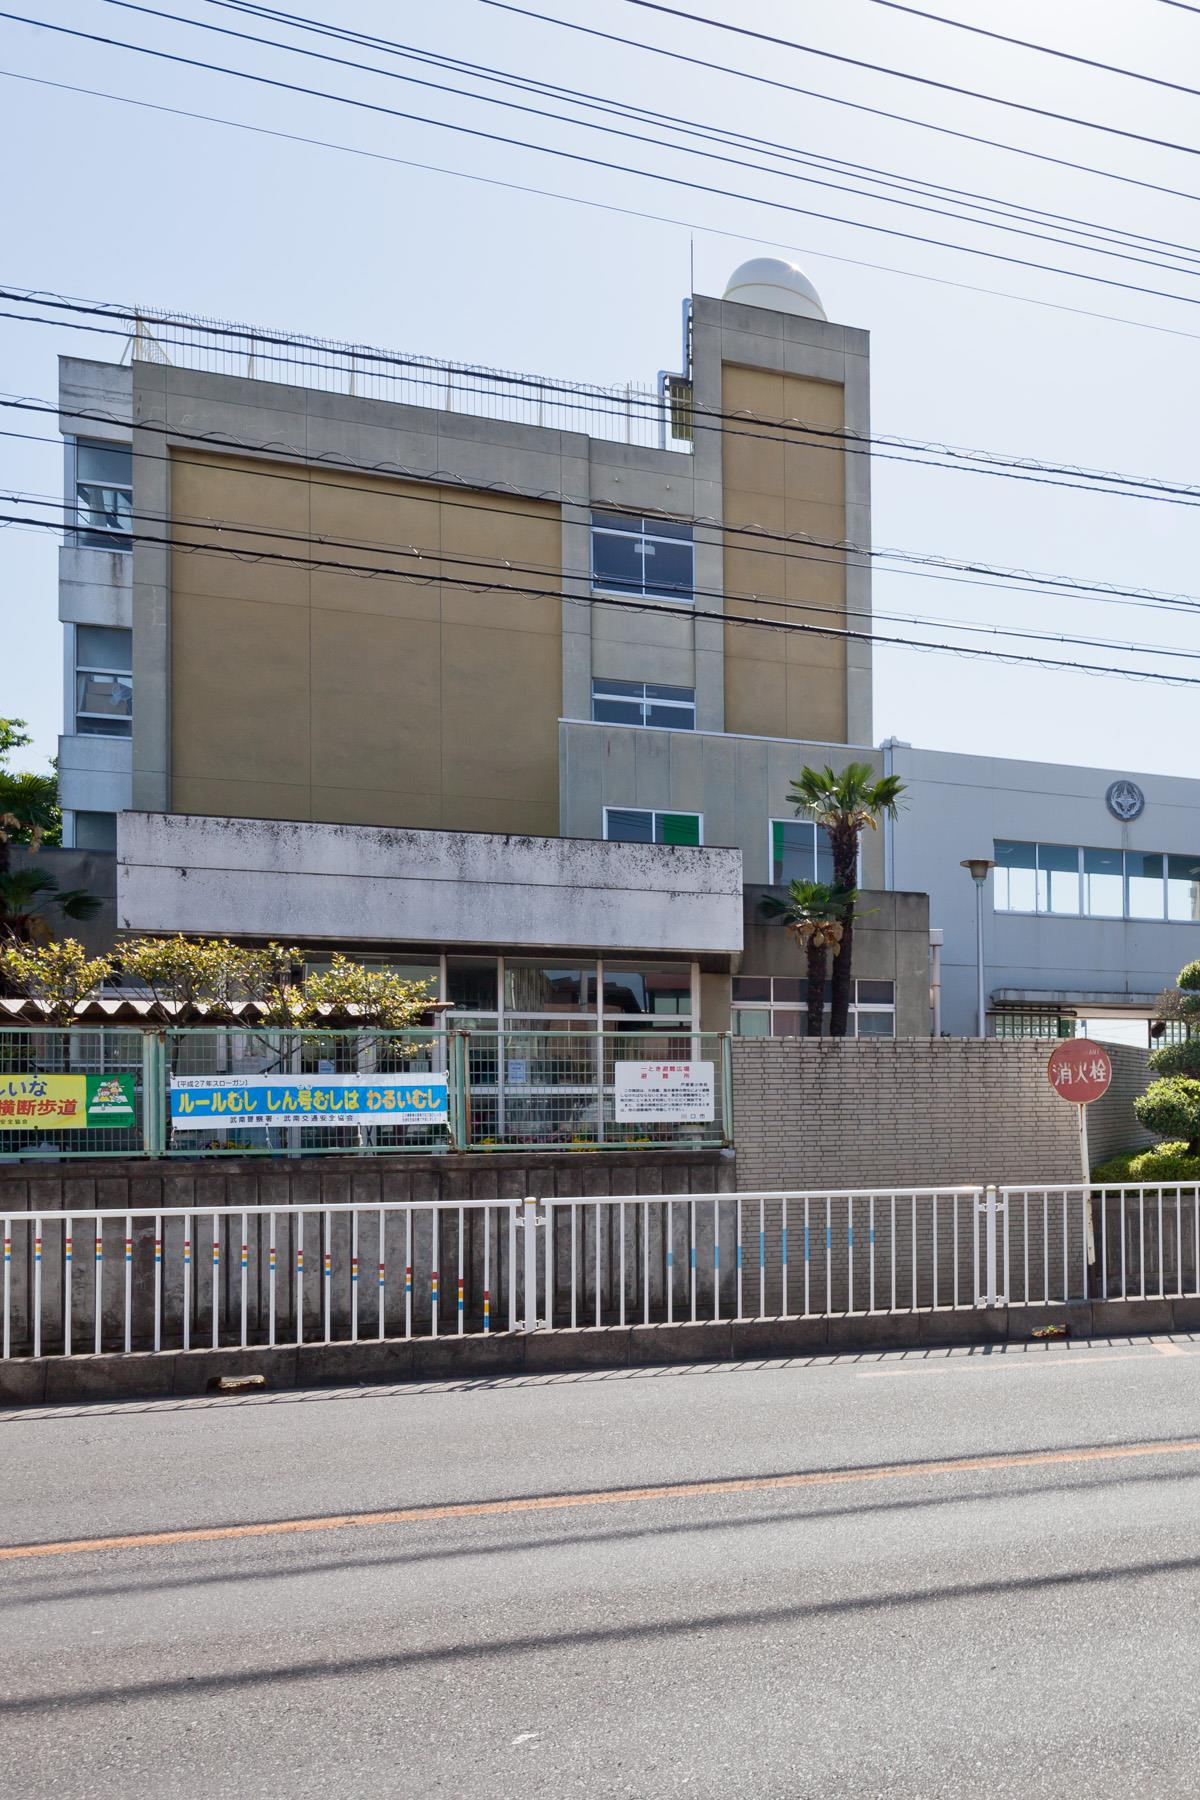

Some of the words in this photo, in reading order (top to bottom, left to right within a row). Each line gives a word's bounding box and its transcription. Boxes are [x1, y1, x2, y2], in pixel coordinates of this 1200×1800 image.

[1052, 1059, 1107, 1086] 消火栓
[0, 1081, 48, 1096] しいな
[0, 1099, 78, 1116] 横断歩道
[178, 1090, 257, 1113] ルールむし
[266, 1089, 360, 1111] しん号むしは
[366, 1088, 441, 1110] わるいむし
